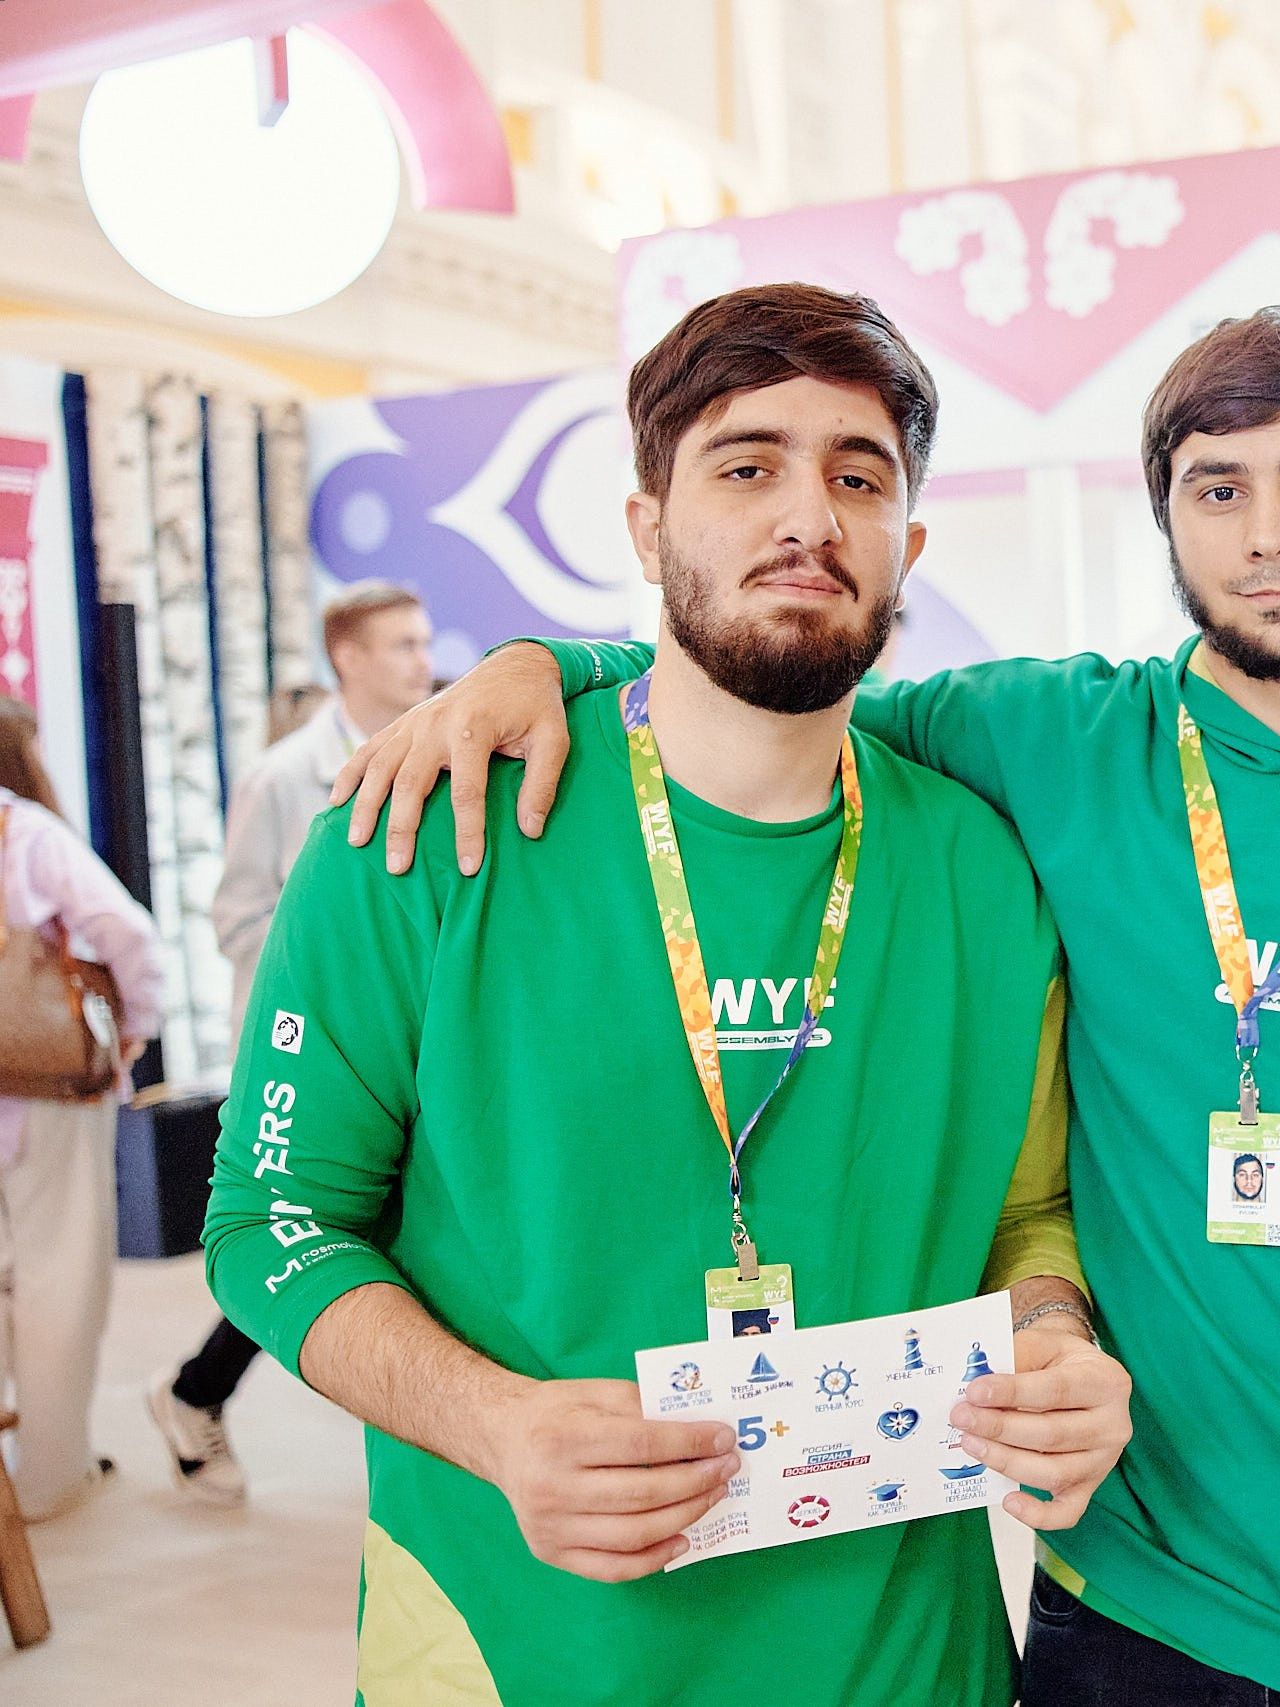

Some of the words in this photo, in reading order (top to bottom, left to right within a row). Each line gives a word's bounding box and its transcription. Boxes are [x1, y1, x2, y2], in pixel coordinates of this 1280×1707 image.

[649, 799, 675, 854] WYF
[825, 875, 845, 926] WYF
[1212, 884, 1239, 937] WYF
[697, 1027, 720, 1083] WYF
[738, 1416, 790, 1451] 5+
[802, 1443, 842, 1454] РОССИЯ
[784, 1456, 869, 1477] ВОЗМОЖНОСТЕЙ
[809, 1451, 849, 1464] СТРАНА
